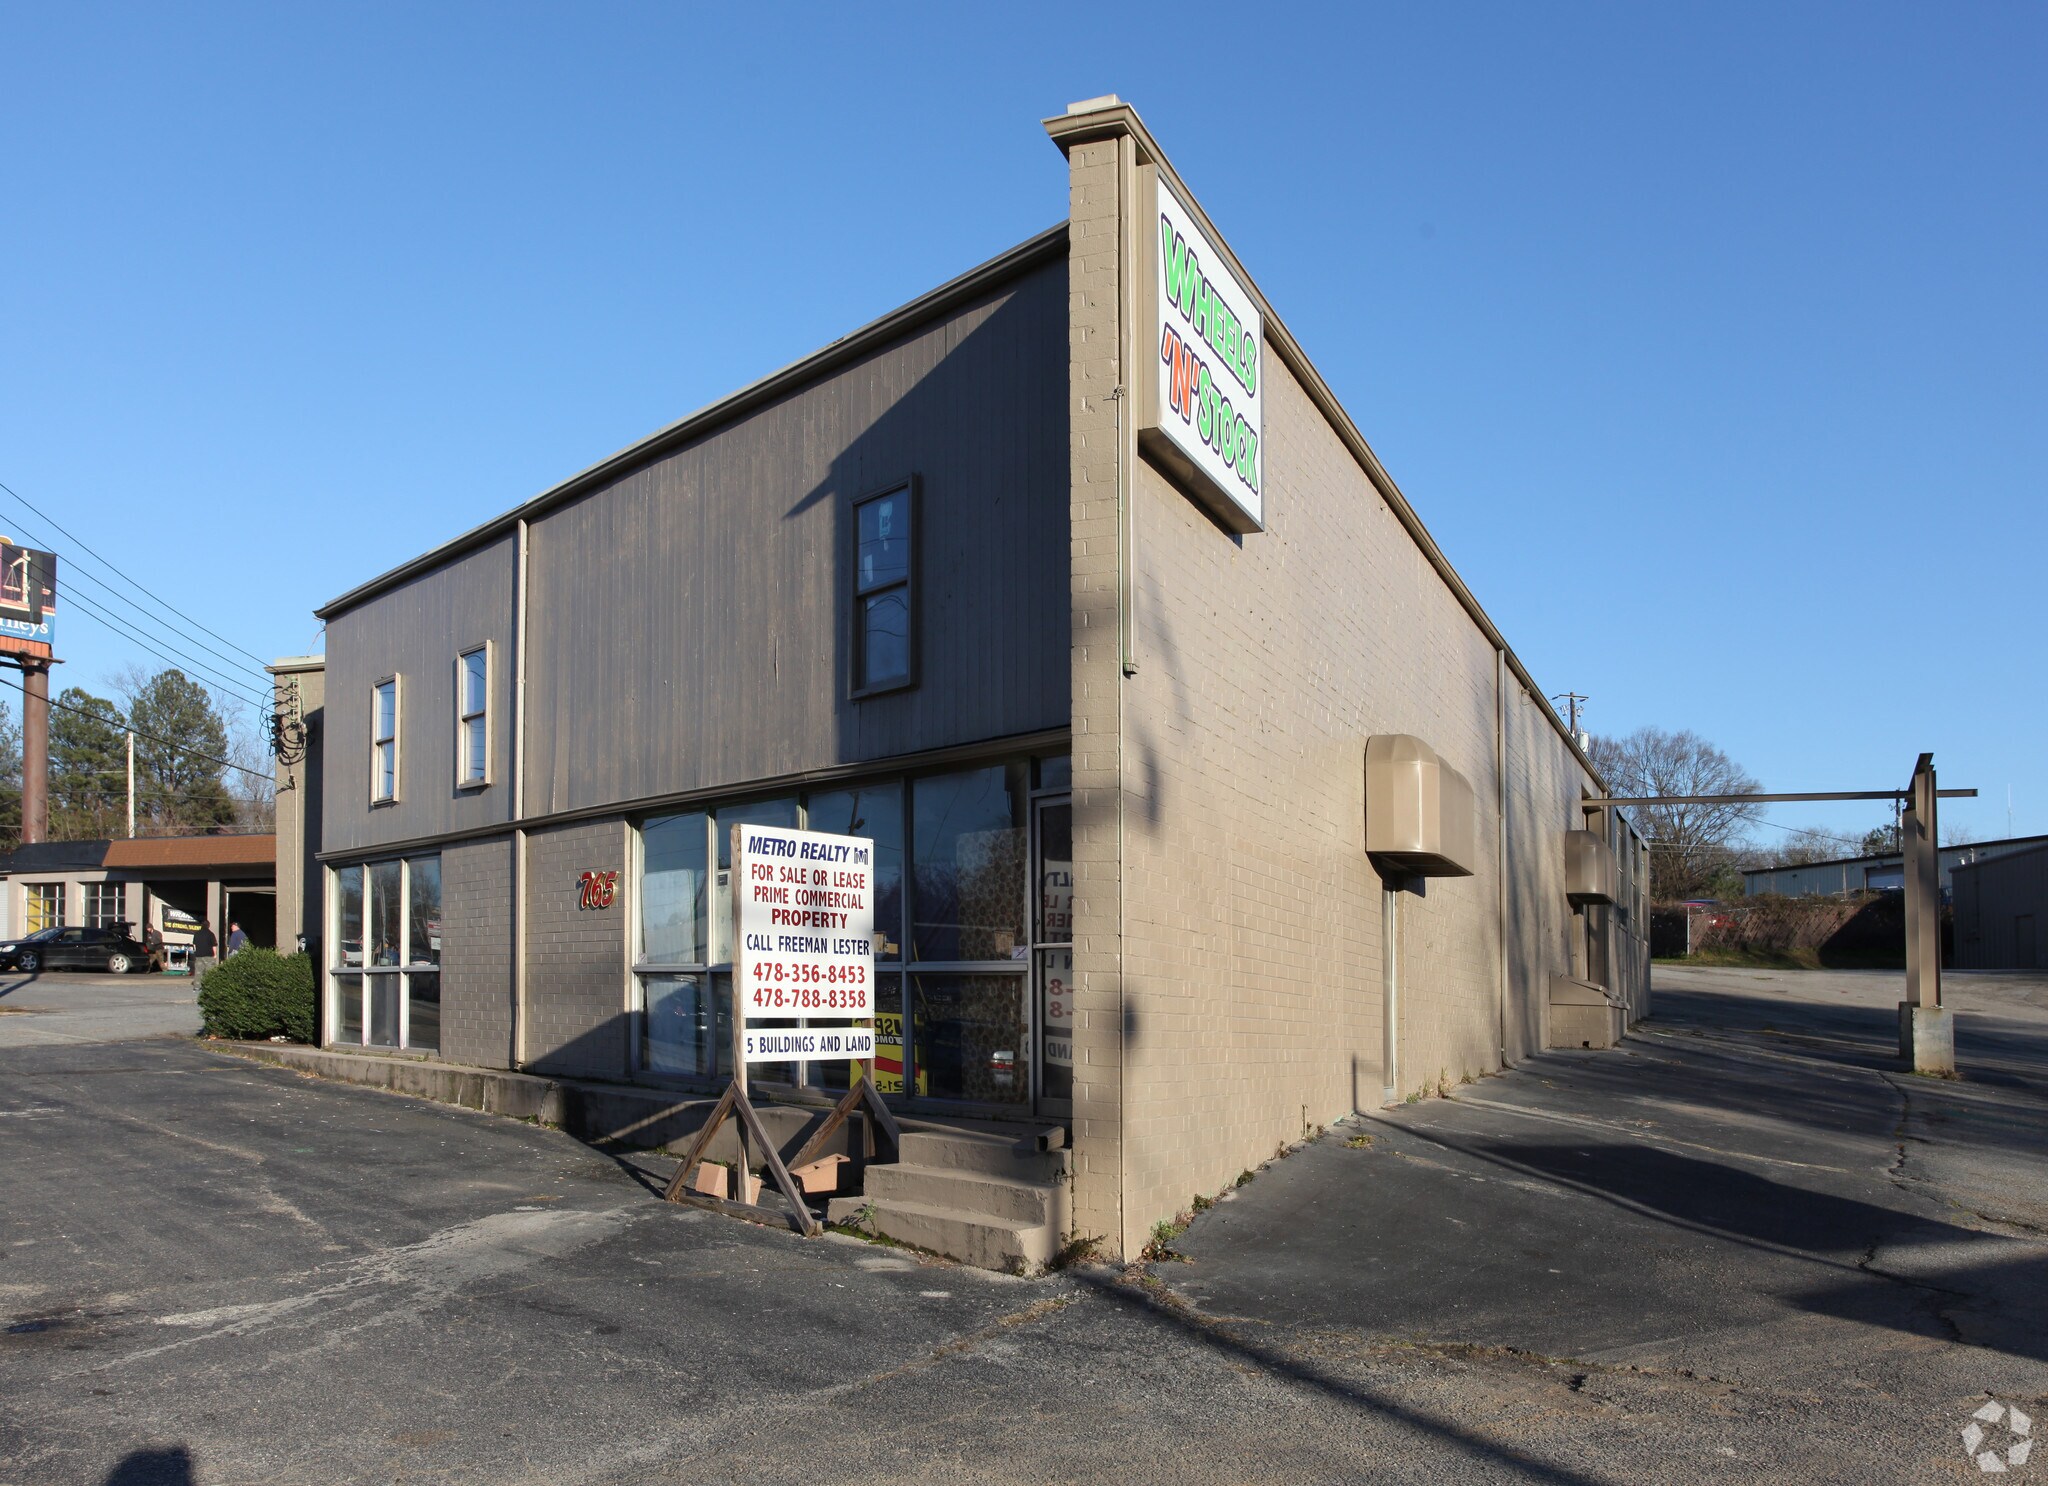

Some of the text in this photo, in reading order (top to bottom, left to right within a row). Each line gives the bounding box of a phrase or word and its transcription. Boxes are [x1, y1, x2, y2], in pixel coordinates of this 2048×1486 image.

[1161, 212, 1257, 398] WHEELS
[748, 835, 797, 858] METRO
[800, 841, 850, 863] REALTY
[751, 863, 865, 889] FOR SALE OR LEASE
[579, 870, 618, 909] 765
[754, 885, 864, 909] PRIME COMMERCIAL
[772, 908, 848, 929] PROPERTY
[747, 933, 870, 956] CALL FREEMAN LESTER
[753, 962, 866, 984] 478-356-8453
[753, 988, 866, 1008] 478-788-8358
[747, 1037, 754, 1054] 5
[759, 1036, 815, 1053] BUILDINGS
[820, 1035, 841, 1052] AND
[845, 1035, 871, 1052] LAND
